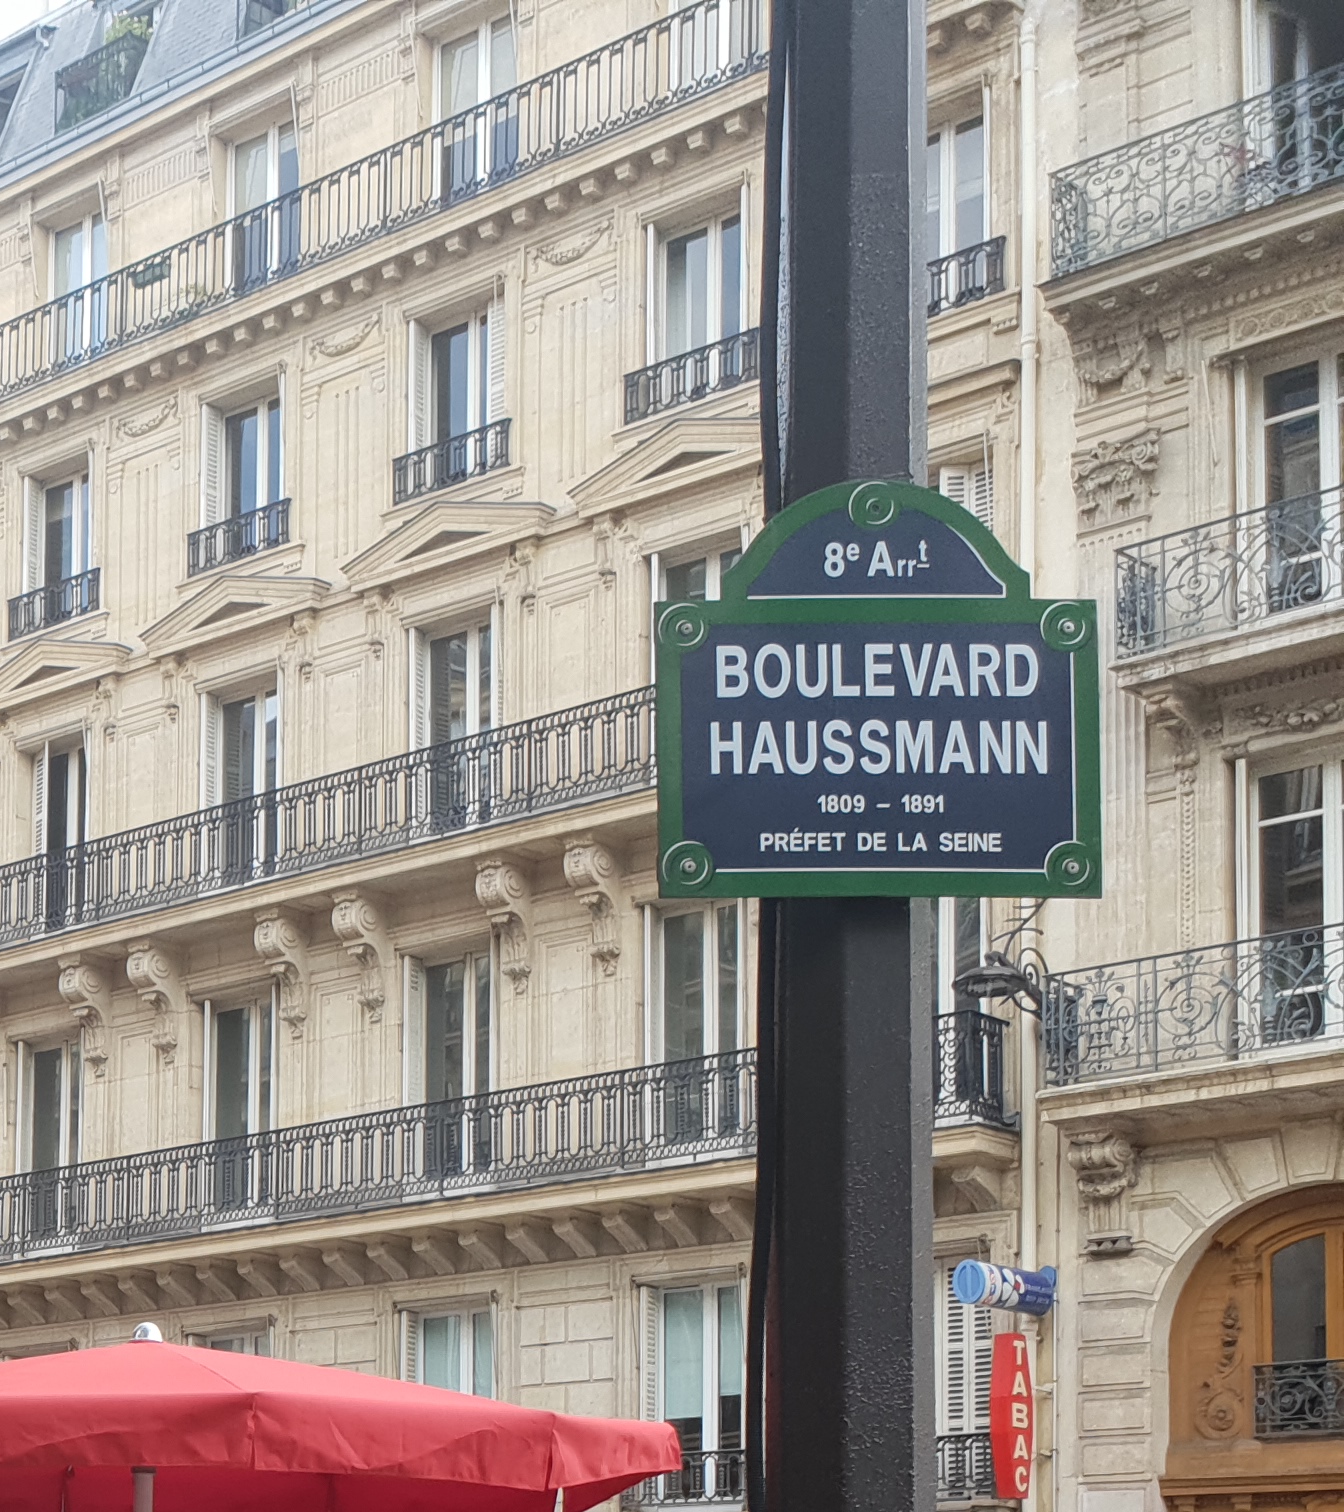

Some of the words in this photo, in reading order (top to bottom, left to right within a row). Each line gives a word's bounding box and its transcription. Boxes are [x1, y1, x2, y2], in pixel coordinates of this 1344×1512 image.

[715, 643, 1040, 699] BOULEVARD
[710, 720, 1049, 775] HAUSSMANN
[817, 794, 866, 815] 1809
[900, 794, 945, 814] 1891
[760, 827, 846, 853] PRÉFET
[857, 832, 888, 852] DE
[897, 832, 928, 852] LA
[939, 832, 1003, 853] SEINE
[1012, 1339, 1030, 1493] TABAC
